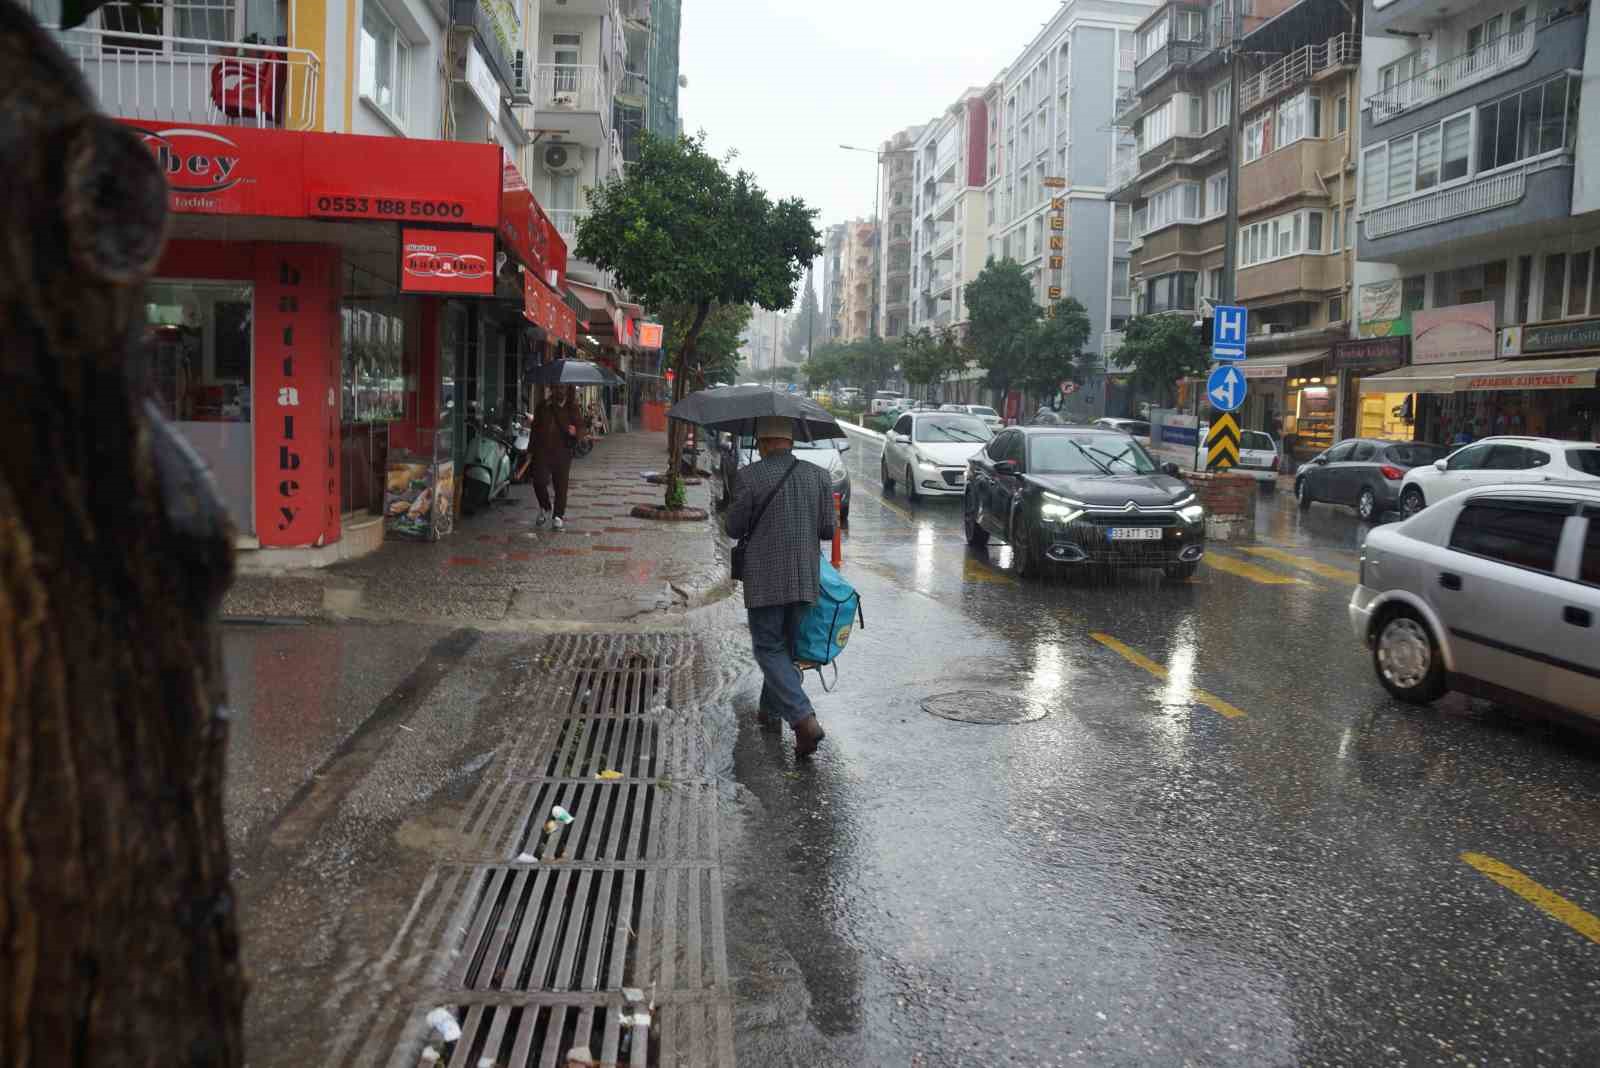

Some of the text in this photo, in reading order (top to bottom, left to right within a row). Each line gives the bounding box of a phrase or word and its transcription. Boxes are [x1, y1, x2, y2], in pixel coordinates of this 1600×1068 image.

[317, 197, 464, 217] 0553 188 5000
[1219, 311, 1242, 340] H
[277, 258, 302, 531] battalbey
